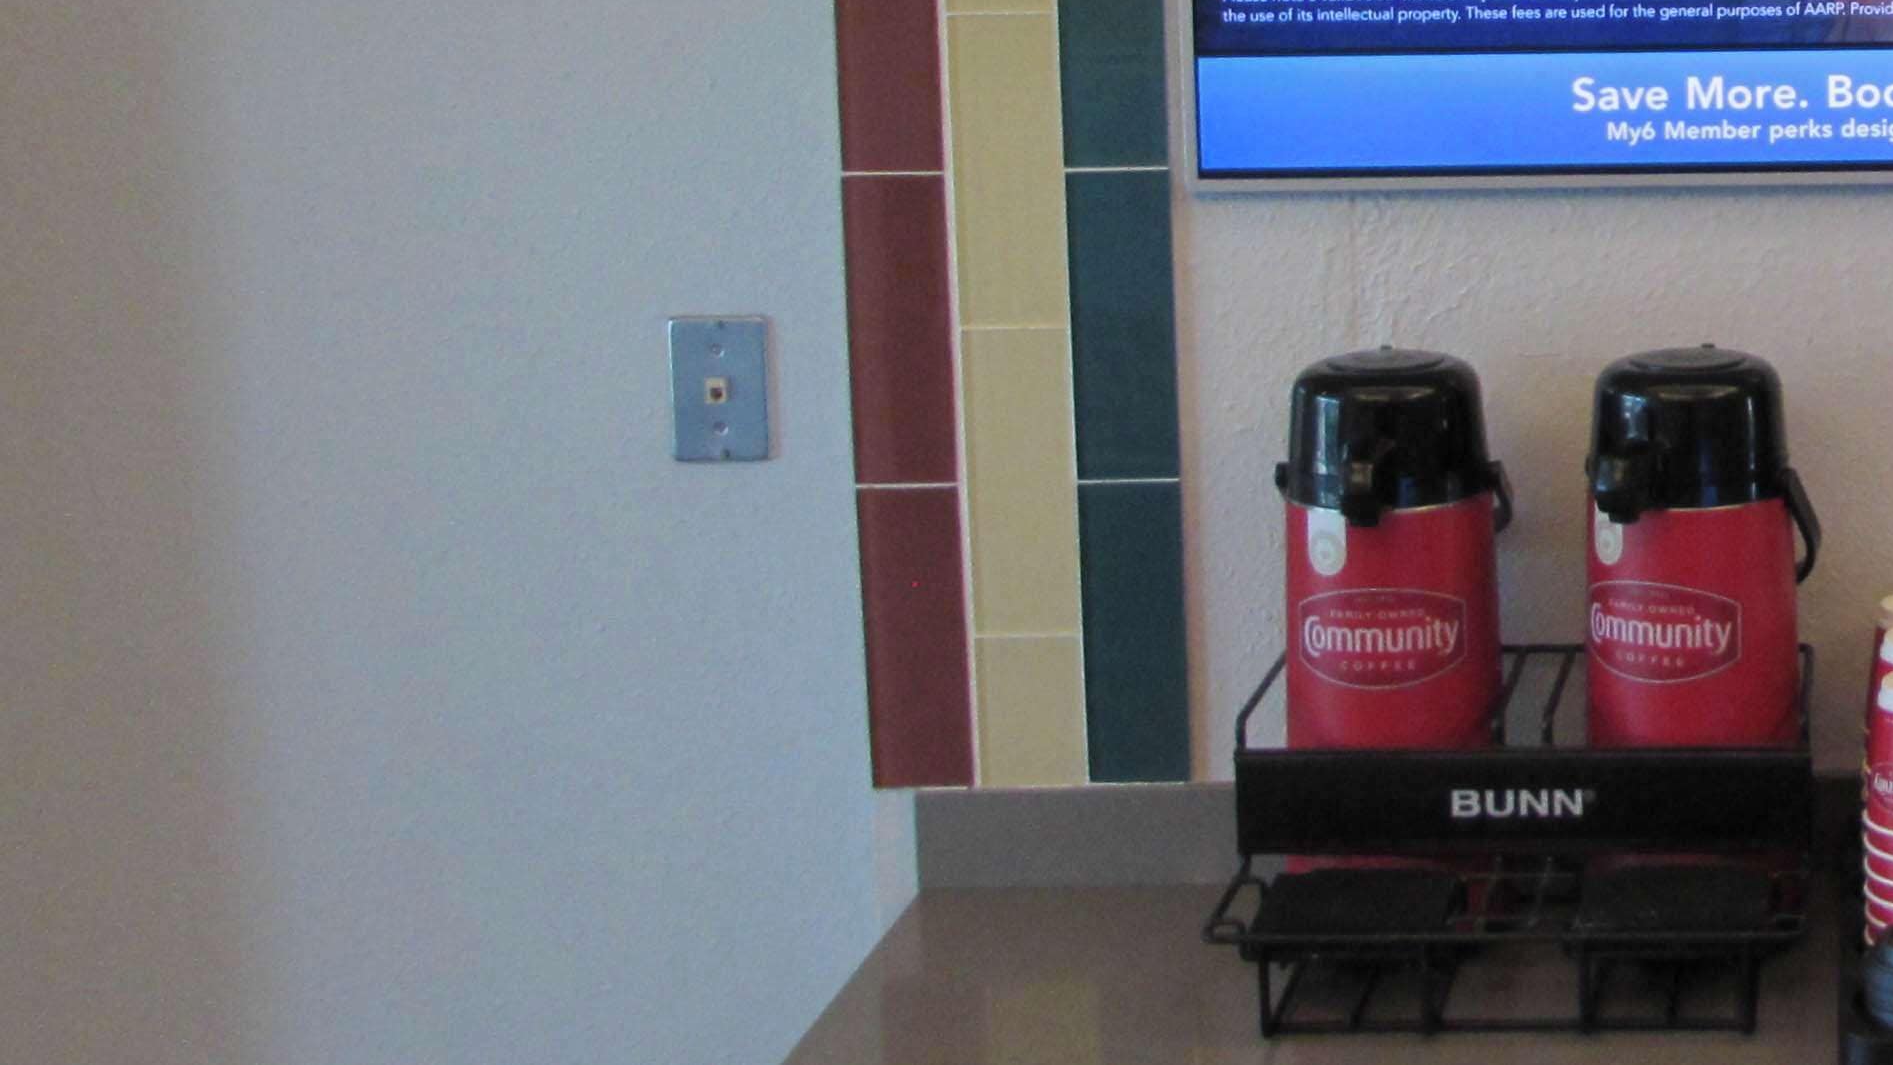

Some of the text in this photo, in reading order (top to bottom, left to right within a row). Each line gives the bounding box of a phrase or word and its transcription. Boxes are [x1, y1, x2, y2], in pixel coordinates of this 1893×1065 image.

[1223, 8, 1246, 22] the
[1250, 12, 1274, 22] use
[1279, 8, 1294, 22] of
[1297, 8, 1313, 22] its
[1317, 7, 1394, 21] intellectual
[1398, 9, 1461, 24] property.
[1466, 6, 1507, 20] These
[1512, 5, 1541, 19] fees
[1545, 9, 1567, 18] are
[1571, 4, 1605, 18] used
[1609, 4, 1628, 18] for
[1633, 4, 1656, 17] the
[1660, 3, 1713, 20] general
[1717, 4, 1782, 20] purposes
[1786, 1, 1800, 16] of
[1804, 2, 1846, 15] AARP.
[1572, 77, 1669, 111] Save
[1686, 76, 1809, 110] More.
[1606, 121, 1656, 146] My6
[1664, 119, 1761, 140] Member
[1769, 119, 1833, 144] perks
[1304, 615, 1459, 658] Community
[1591, 602, 1732, 656] Community
[1450, 789, 1584, 817] BUNN
